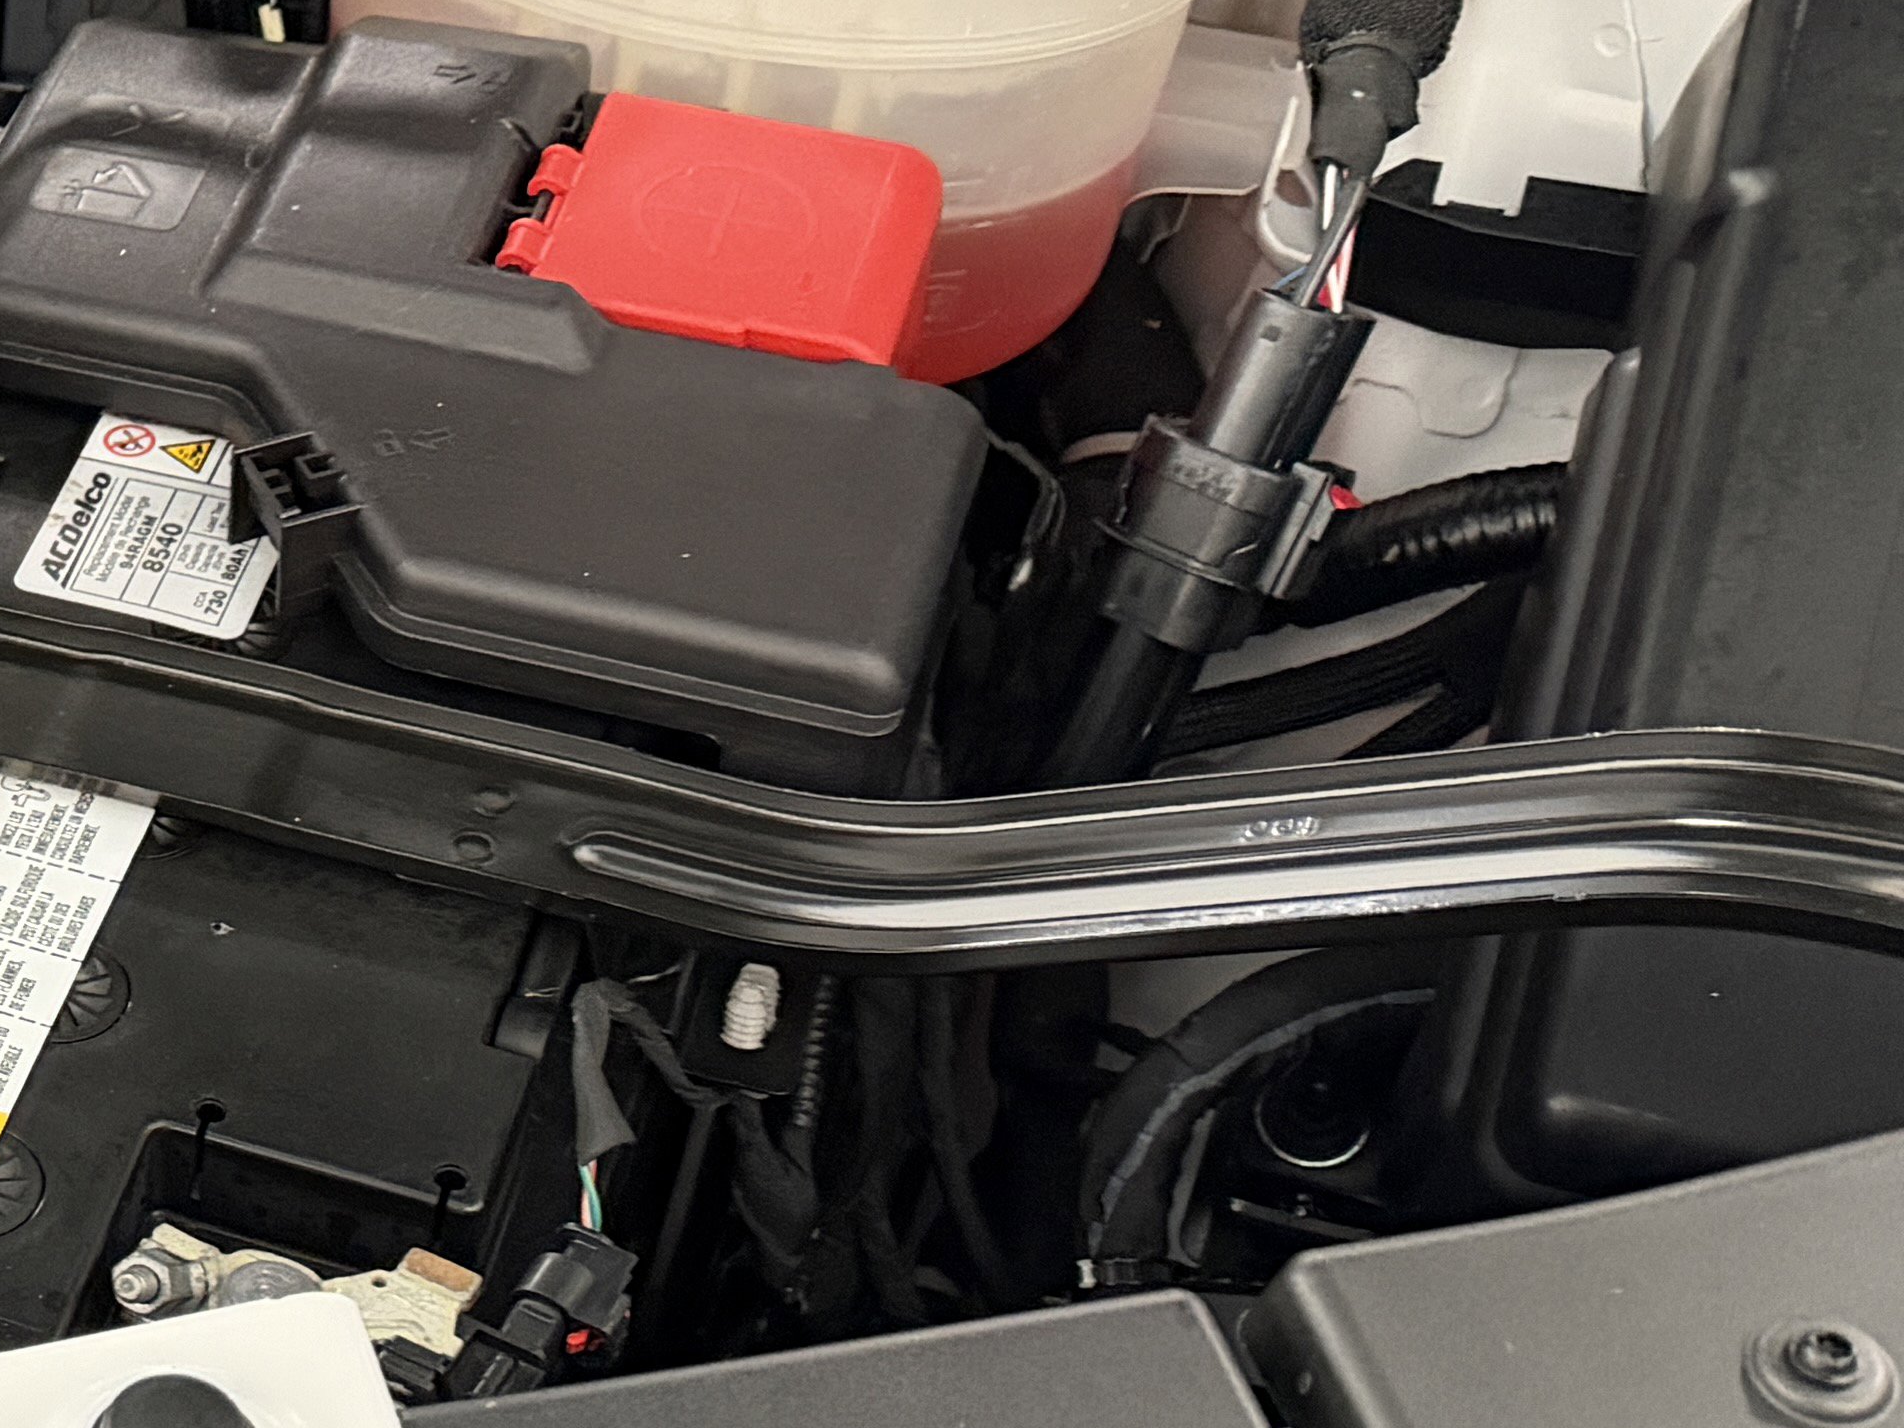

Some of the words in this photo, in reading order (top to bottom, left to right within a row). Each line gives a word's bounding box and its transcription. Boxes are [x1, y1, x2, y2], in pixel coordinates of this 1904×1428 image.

[41, 472, 112, 582] ACDelco
[118, 514, 158, 570] 94RAGM
[140, 520, 185, 574] 8540
[203, 588, 228, 616] 730
